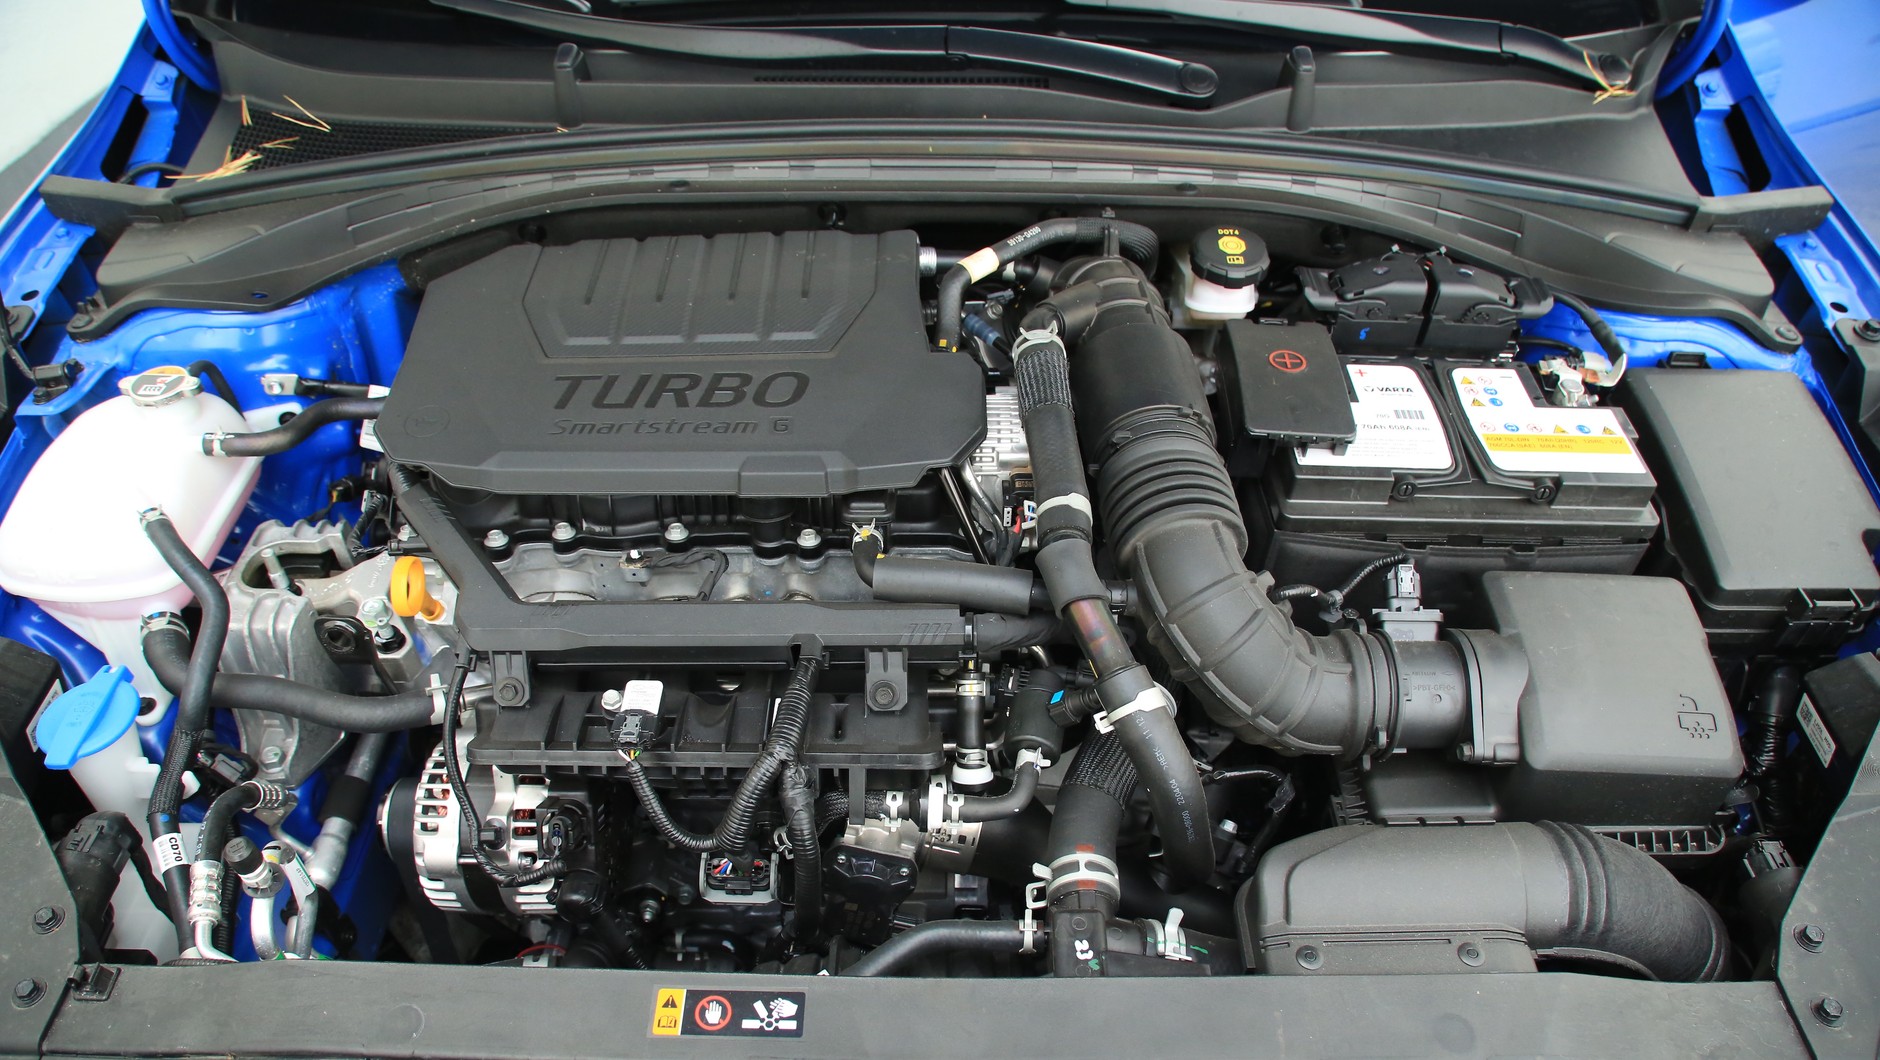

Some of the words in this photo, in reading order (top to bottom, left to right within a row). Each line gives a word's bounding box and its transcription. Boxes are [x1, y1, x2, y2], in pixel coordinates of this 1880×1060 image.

[553, 371, 811, 410] TURBO
[548, 417, 759, 435] Smartstream
[772, 416, 790, 433] G
[1168, 778, 1185, 806] 220404
[168, 836, 184, 862] CD70
